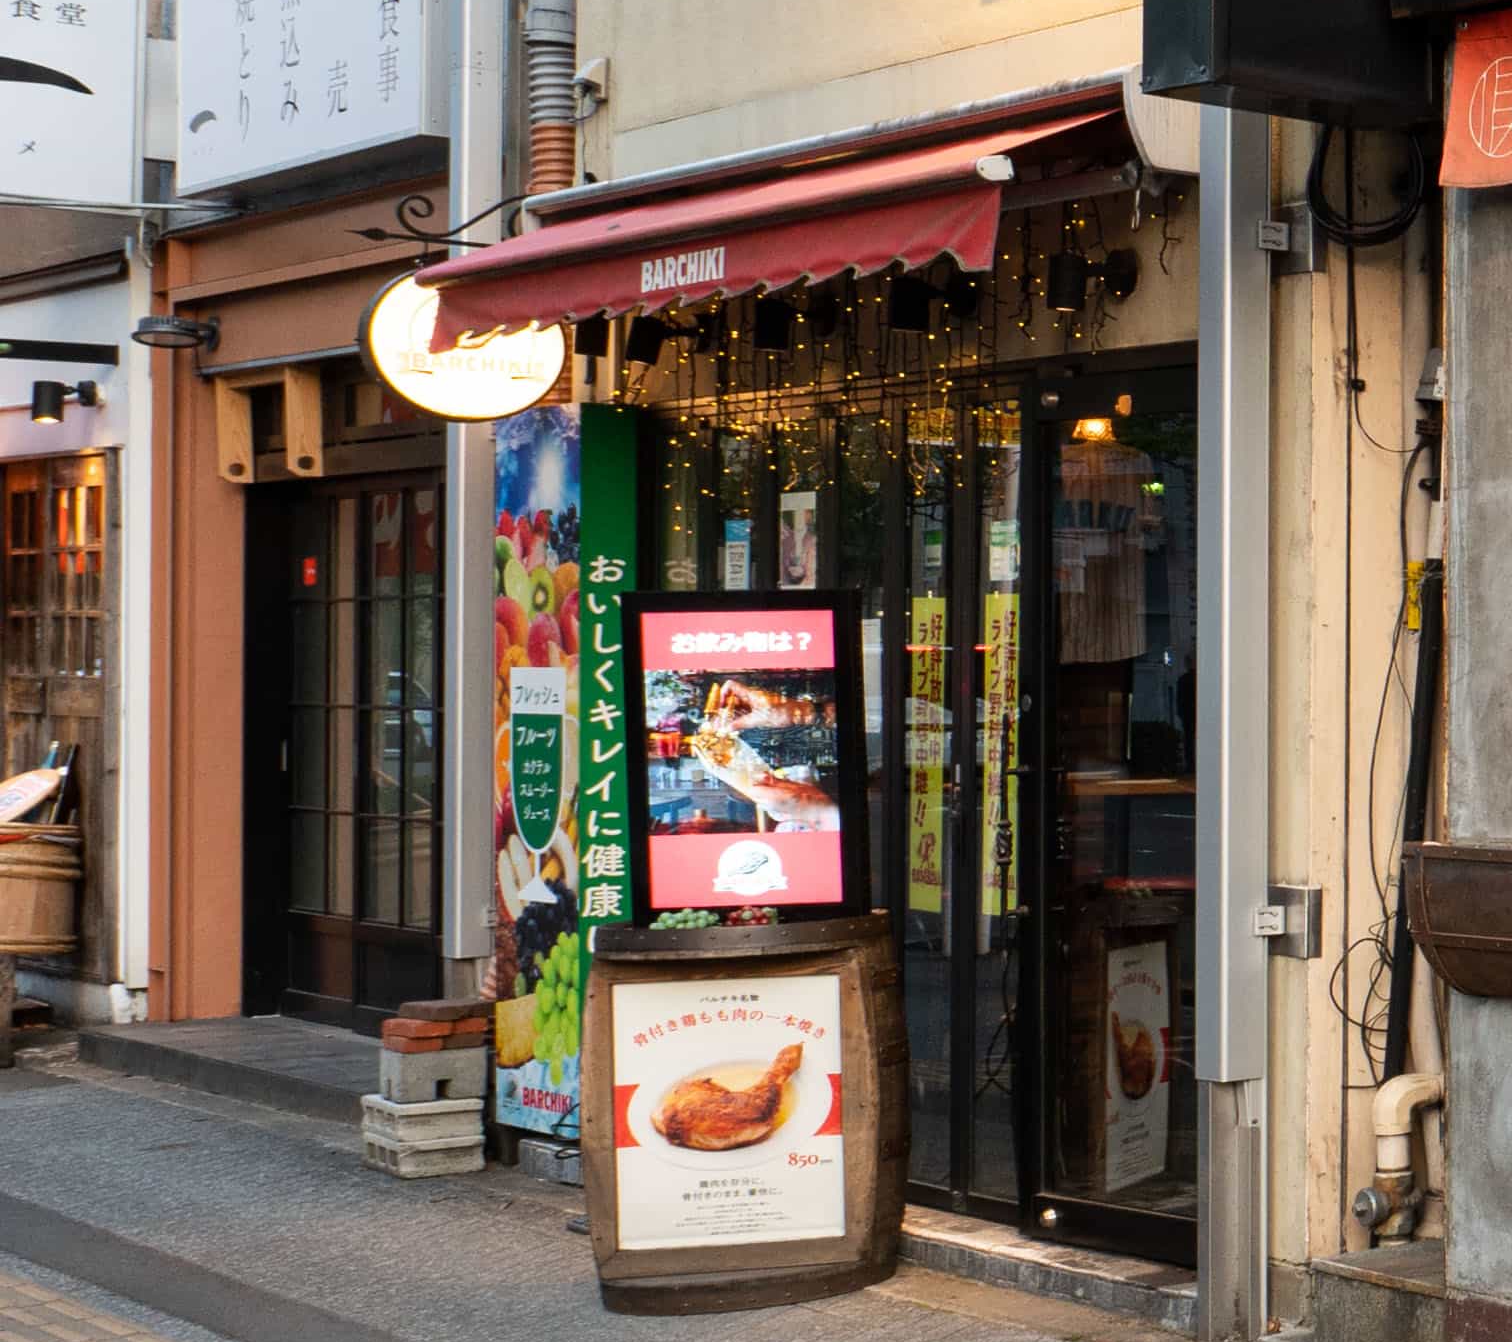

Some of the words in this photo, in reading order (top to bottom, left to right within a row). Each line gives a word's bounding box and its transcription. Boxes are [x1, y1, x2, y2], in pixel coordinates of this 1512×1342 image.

[640, 246, 726, 293] BARCHIKI
[513, 685, 561, 706] フレッシュ
[516, 725, 558, 748] フルーツ
[521, 759, 552, 775] カクテル
[523, 805, 551, 822] ジュース
[787, 1152, 819, 1169] 850
